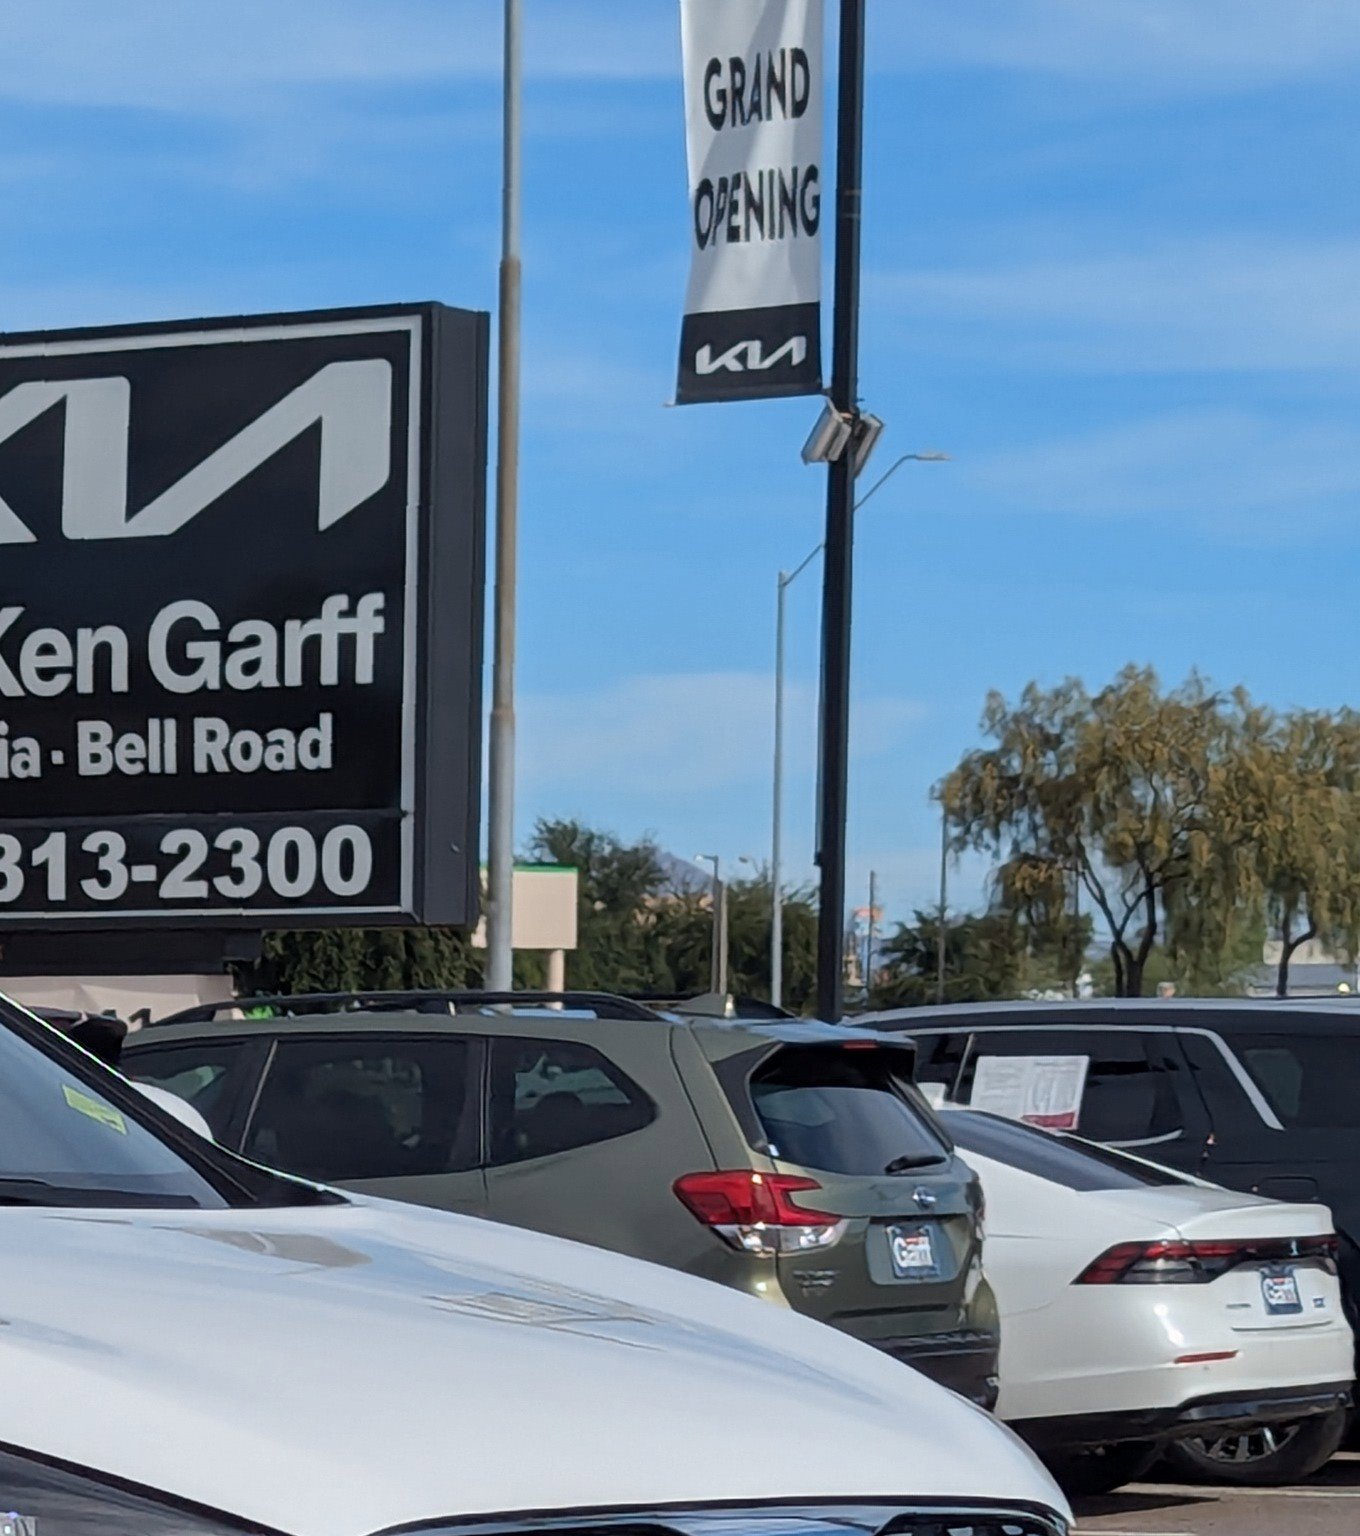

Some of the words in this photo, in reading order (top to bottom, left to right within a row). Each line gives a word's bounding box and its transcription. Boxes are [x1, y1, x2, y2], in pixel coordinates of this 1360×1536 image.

[704, 47, 810, 131] GRAND
[694, 164, 821, 251] OPENING
[695, 335, 807, 375] KIA
[147, 592, 385, 694] Garff
[77, 718, 178, 776] Bell
[193, 713, 332, 773] Road
